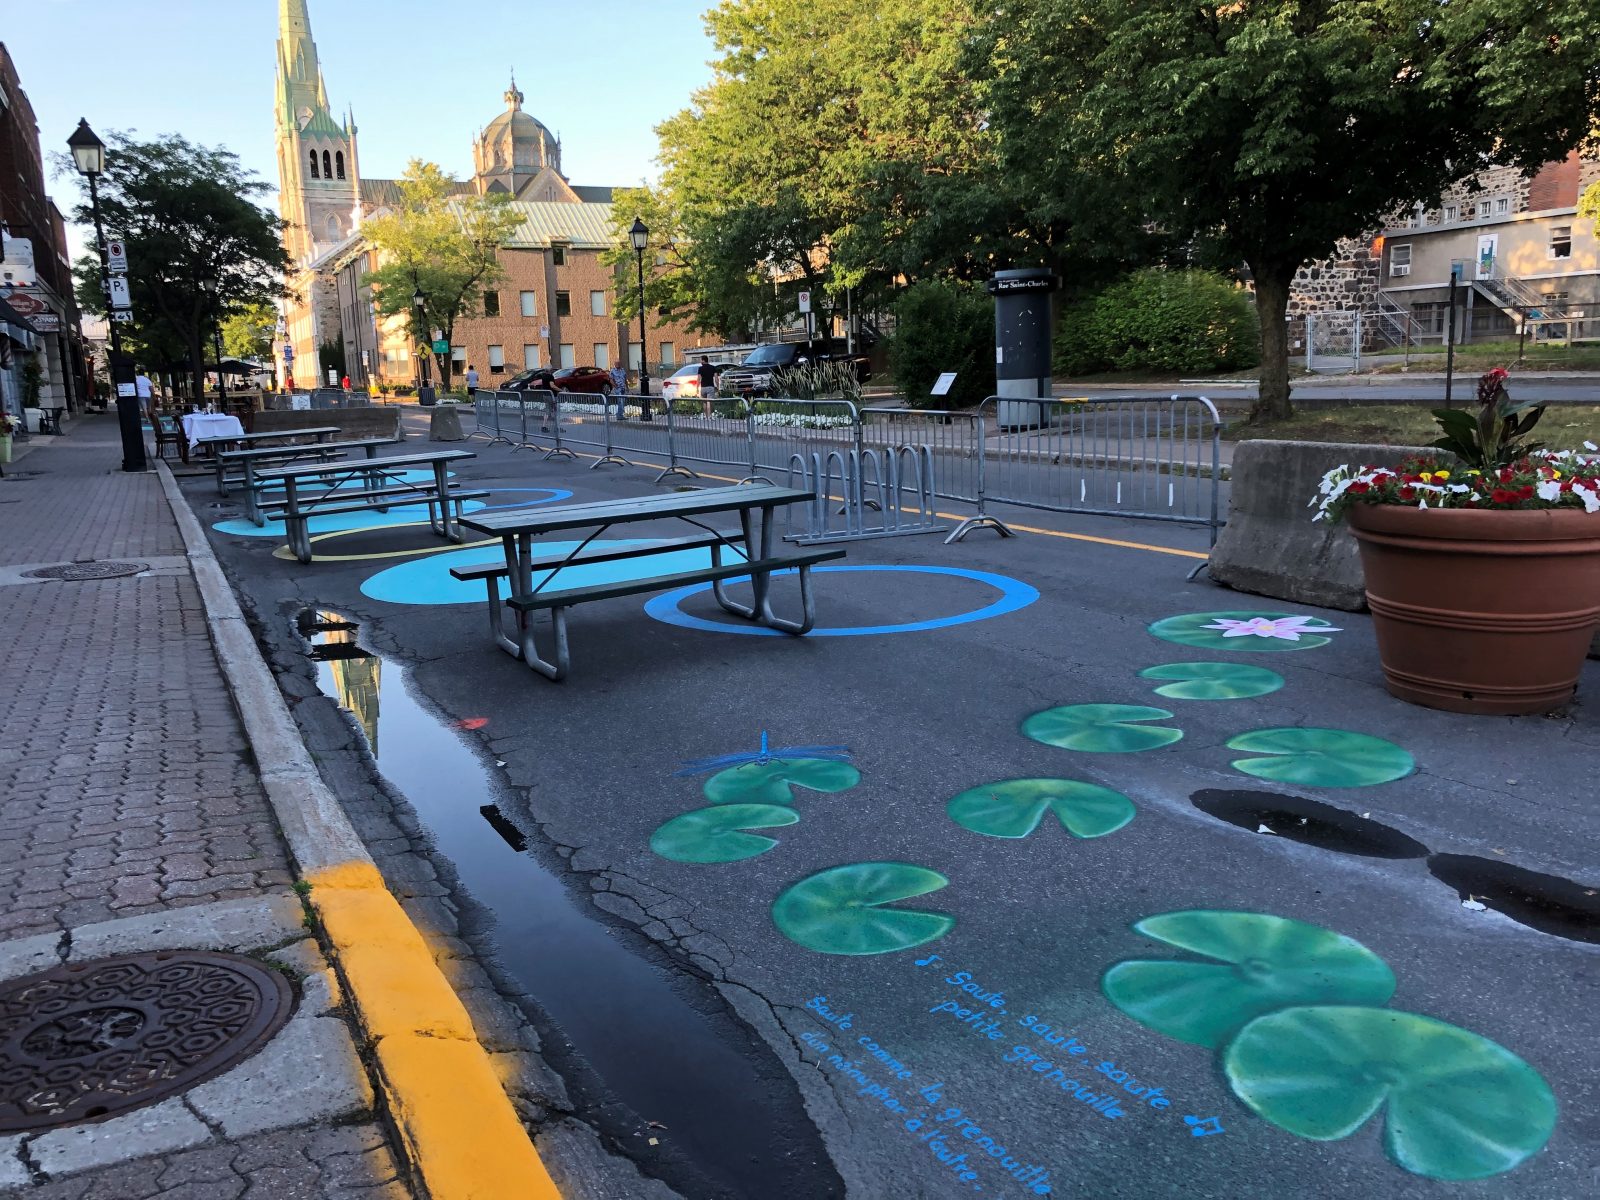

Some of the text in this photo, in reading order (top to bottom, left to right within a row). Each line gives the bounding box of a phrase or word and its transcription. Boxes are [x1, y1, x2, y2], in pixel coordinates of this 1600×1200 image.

[805, 996, 1052, 1195] Saute comme la grenouille
[929, 1001, 1126, 1119] petite grenouille
[1095, 1061, 1171, 1111] saute
[904, 1112, 924, 1133] à
